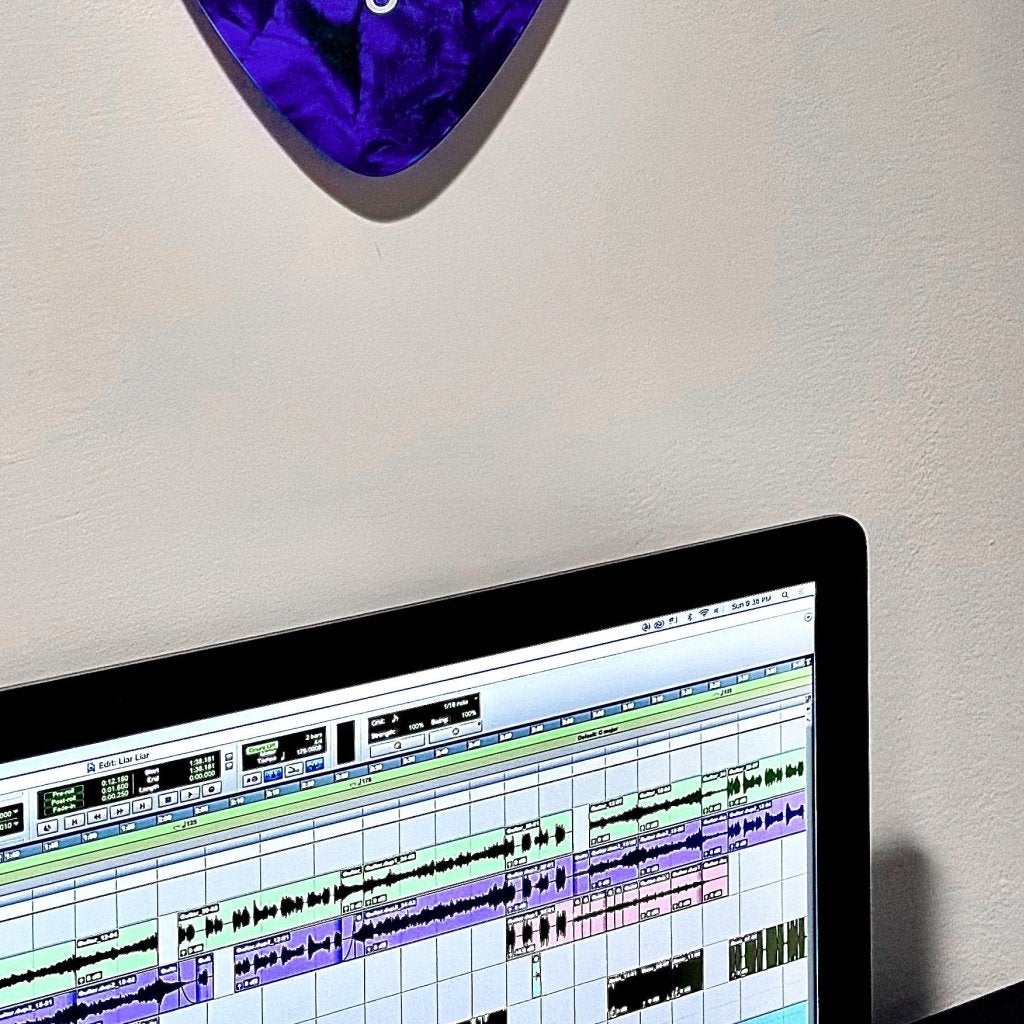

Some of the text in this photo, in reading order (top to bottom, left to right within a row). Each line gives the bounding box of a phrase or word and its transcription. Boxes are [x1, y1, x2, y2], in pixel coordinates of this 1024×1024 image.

[98, 753, 150, 770] Edit: Liar Liar
